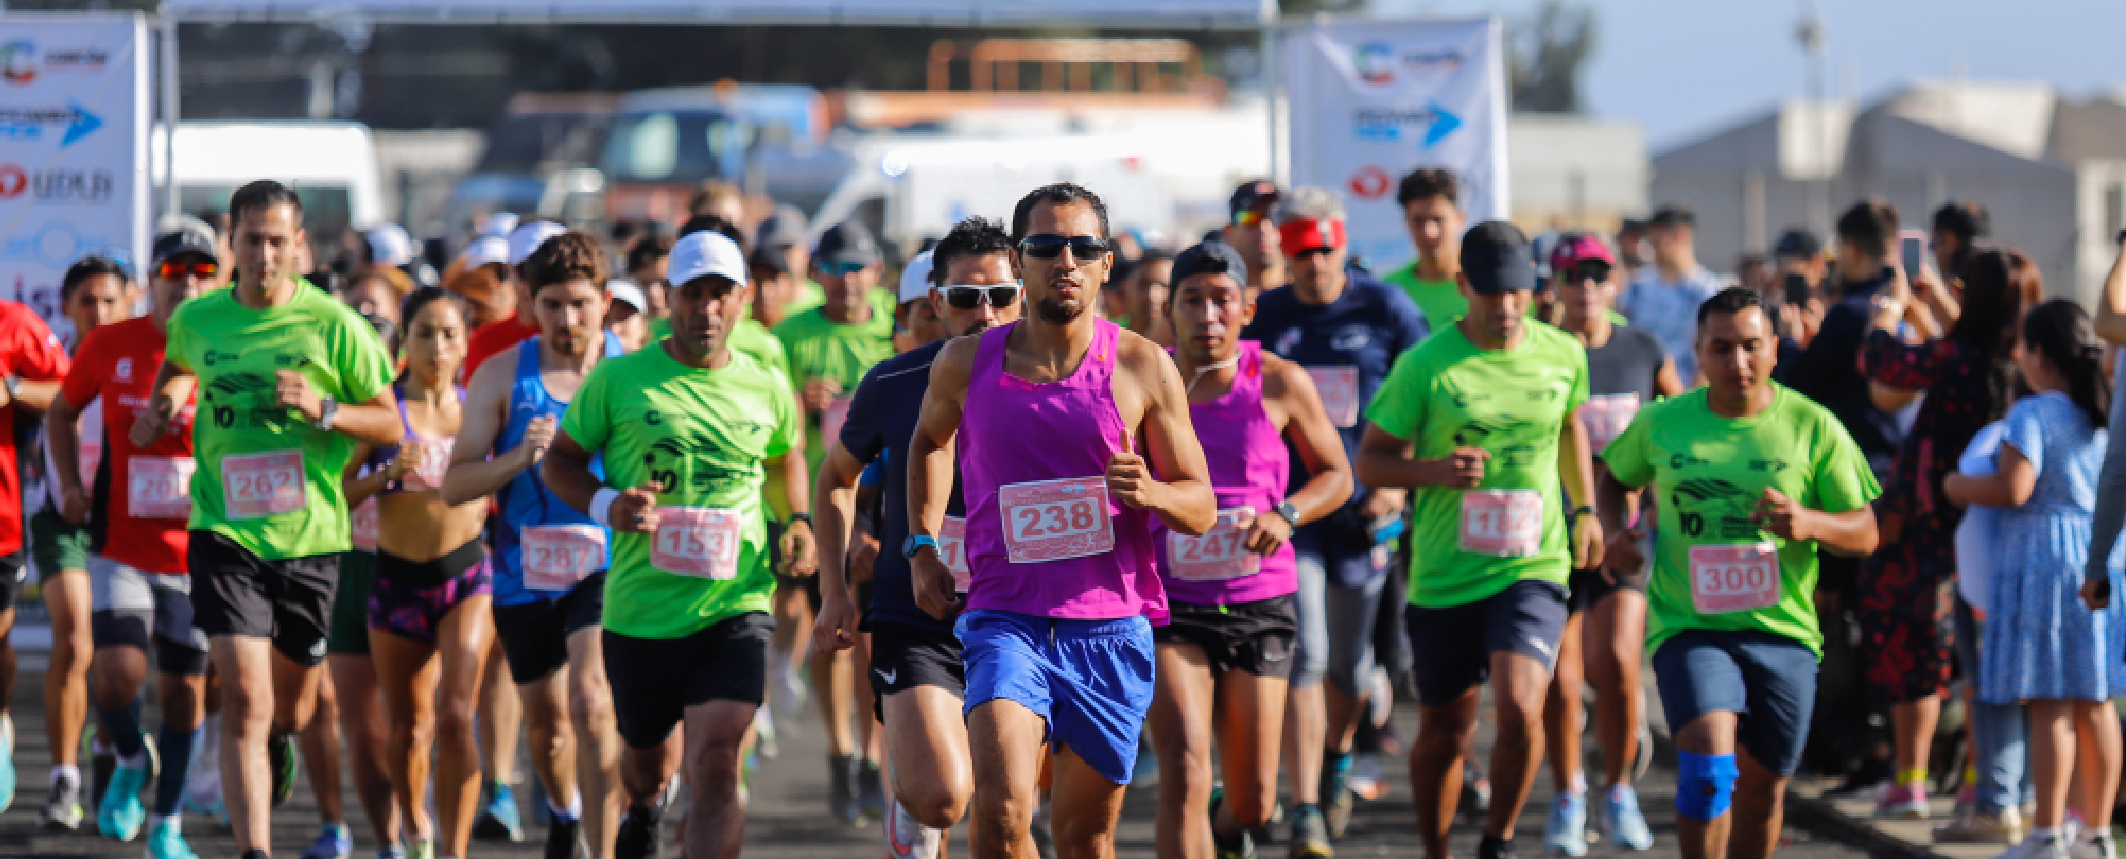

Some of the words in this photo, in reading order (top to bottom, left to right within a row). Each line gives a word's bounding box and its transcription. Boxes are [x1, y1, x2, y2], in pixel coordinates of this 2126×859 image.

[236, 471, 291, 498] 262
[1018, 500, 1094, 539] 238
[1679, 512, 1704, 538] 10
[666, 529, 725, 557] 153
[1182, 530, 1242, 560] 247
[534, 546, 590, 569] 287
[1704, 566, 1765, 592] 300
